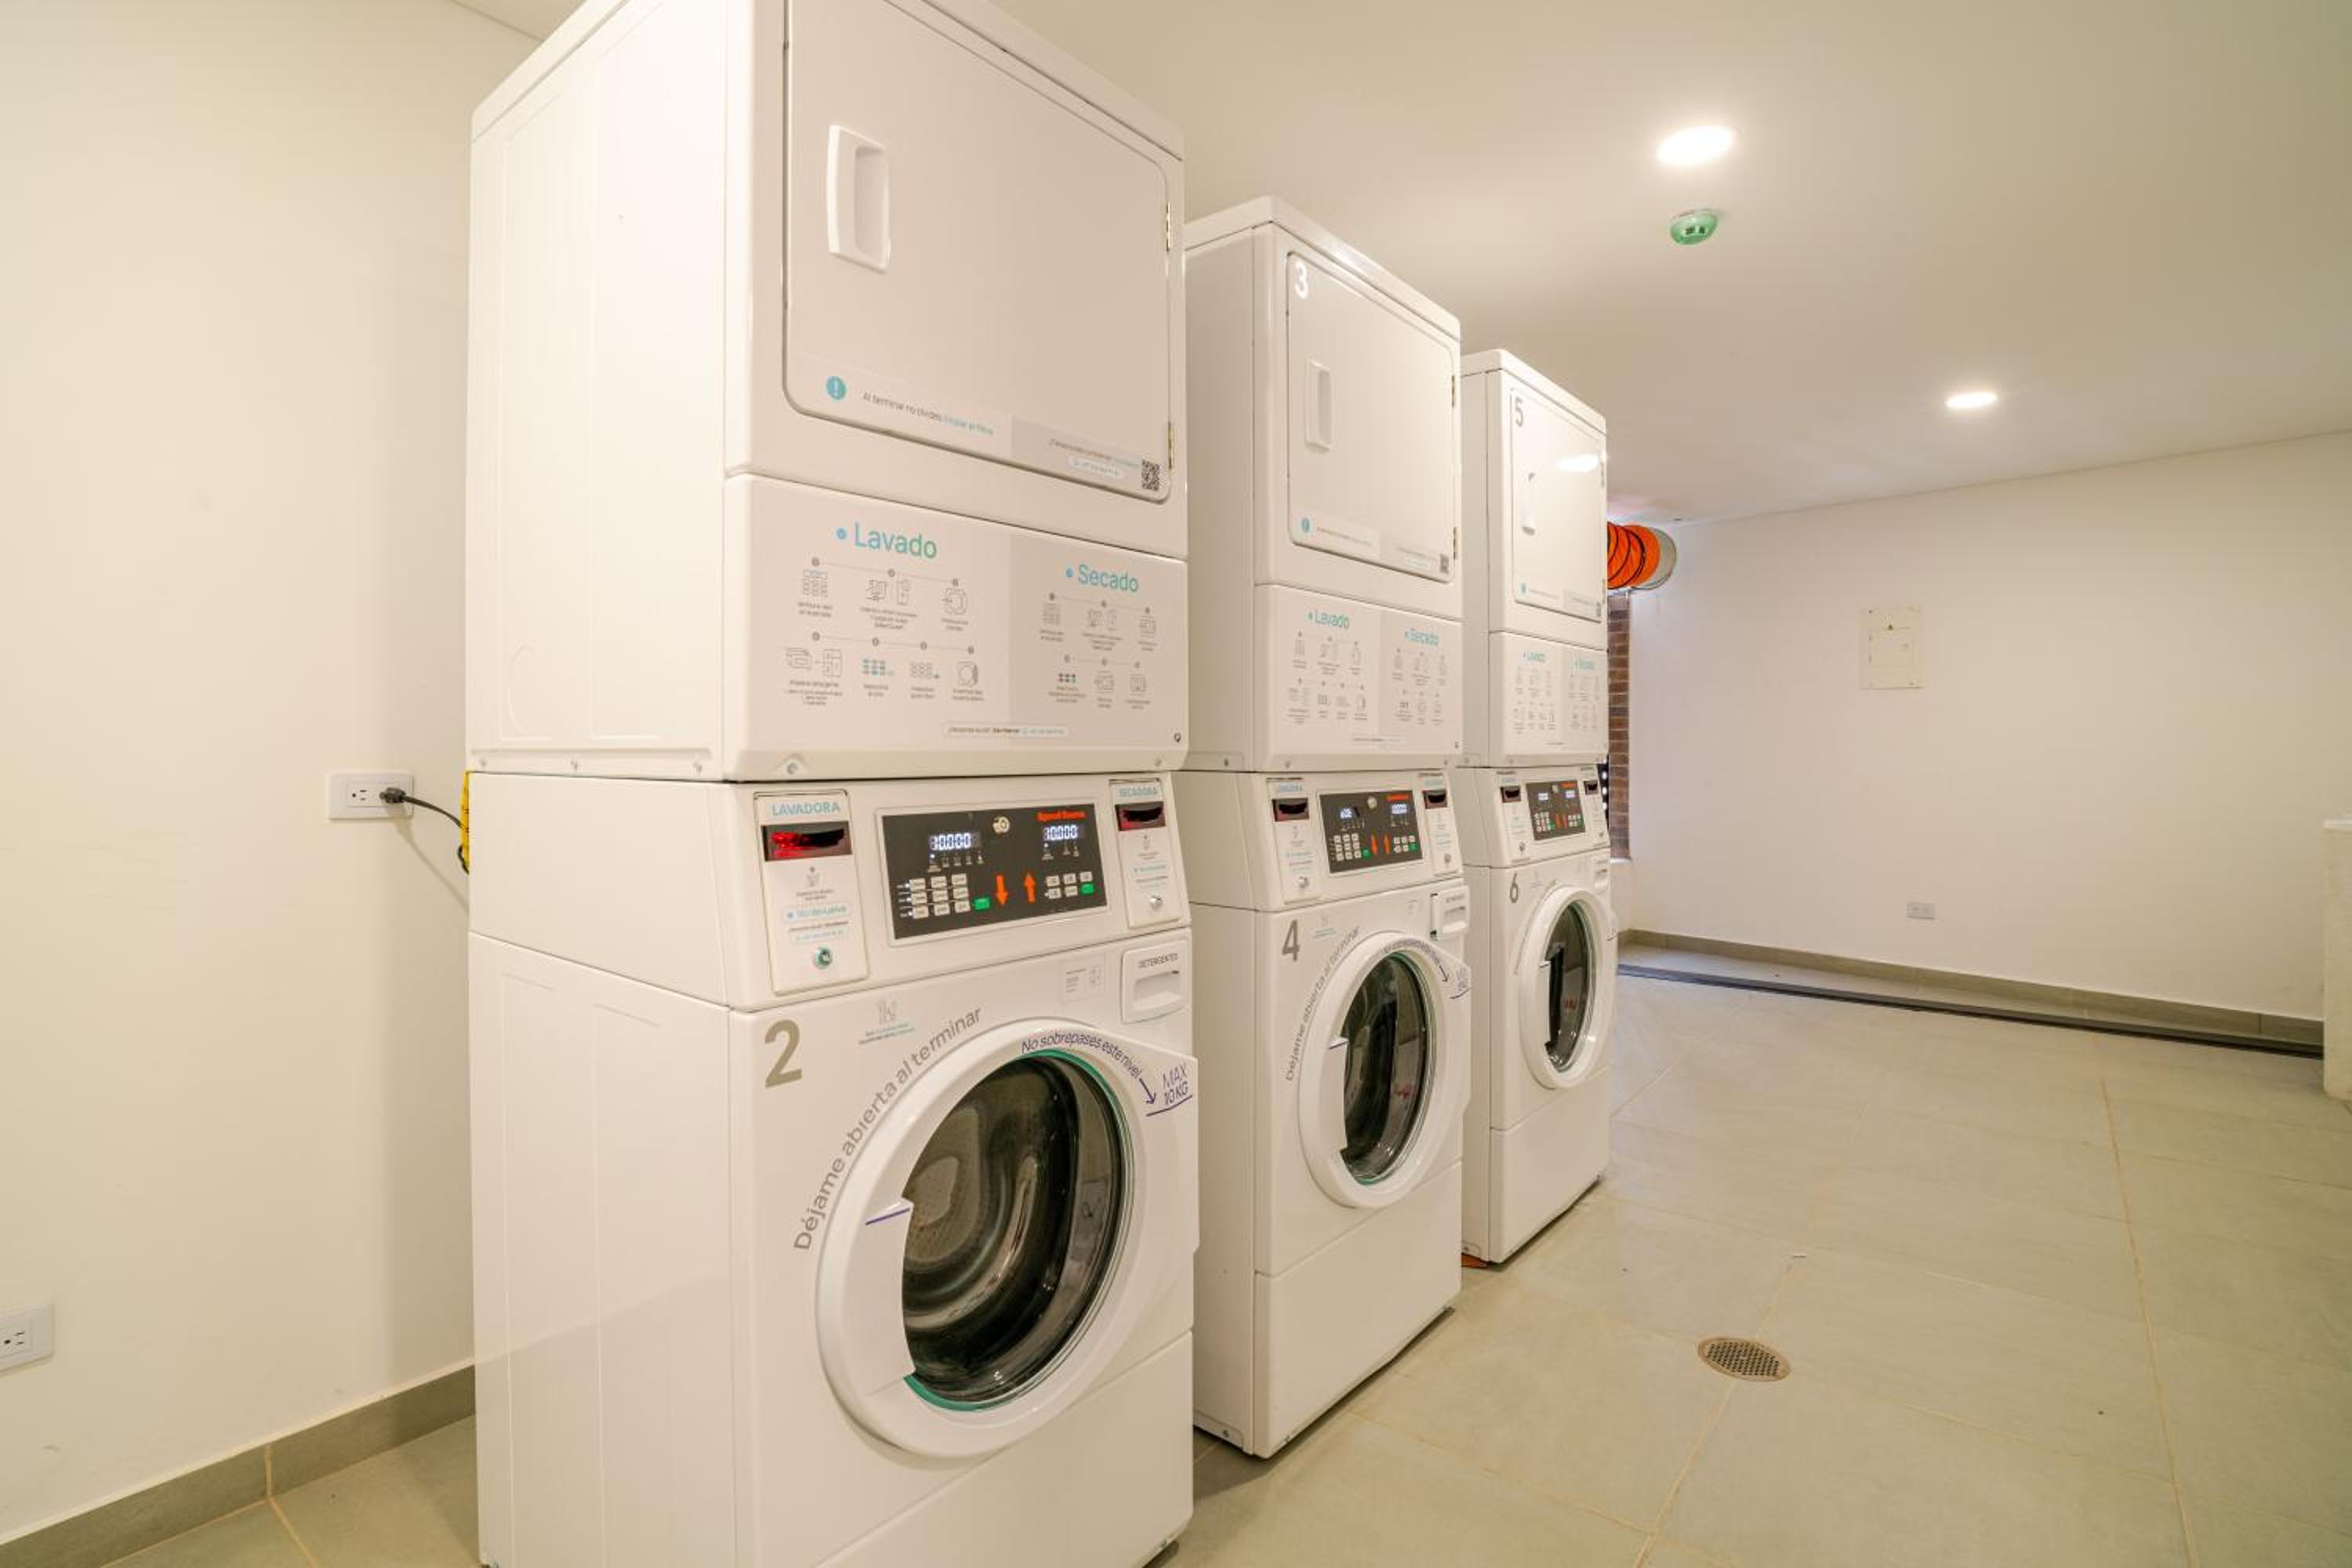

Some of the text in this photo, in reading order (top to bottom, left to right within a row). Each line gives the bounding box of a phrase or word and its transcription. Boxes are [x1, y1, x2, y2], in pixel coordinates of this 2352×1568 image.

[1294, 260, 1308, 299] 3
[1515, 396, 1524, 426] 5
[854, 521, 938, 560] Lavado
[1078, 564, 1139, 593] Secado
[1315, 610, 1349, 629] Lavado
[772, 802, 840, 816] LAVADORA
[1509, 872, 1519, 903] 6
[1282, 920, 1301, 962] 4
[764, 1019, 803, 1089] 2
[1022, 1032, 1142, 1078] No sobrepases este nivel
[1163, 1062, 1187, 1089] MAX
[793, 1157, 845, 1250] Déjame
[842, 1082, 898, 1156] abierta
[896, 1060, 913, 1083] al
[911, 1007, 981, 1066] terminar
